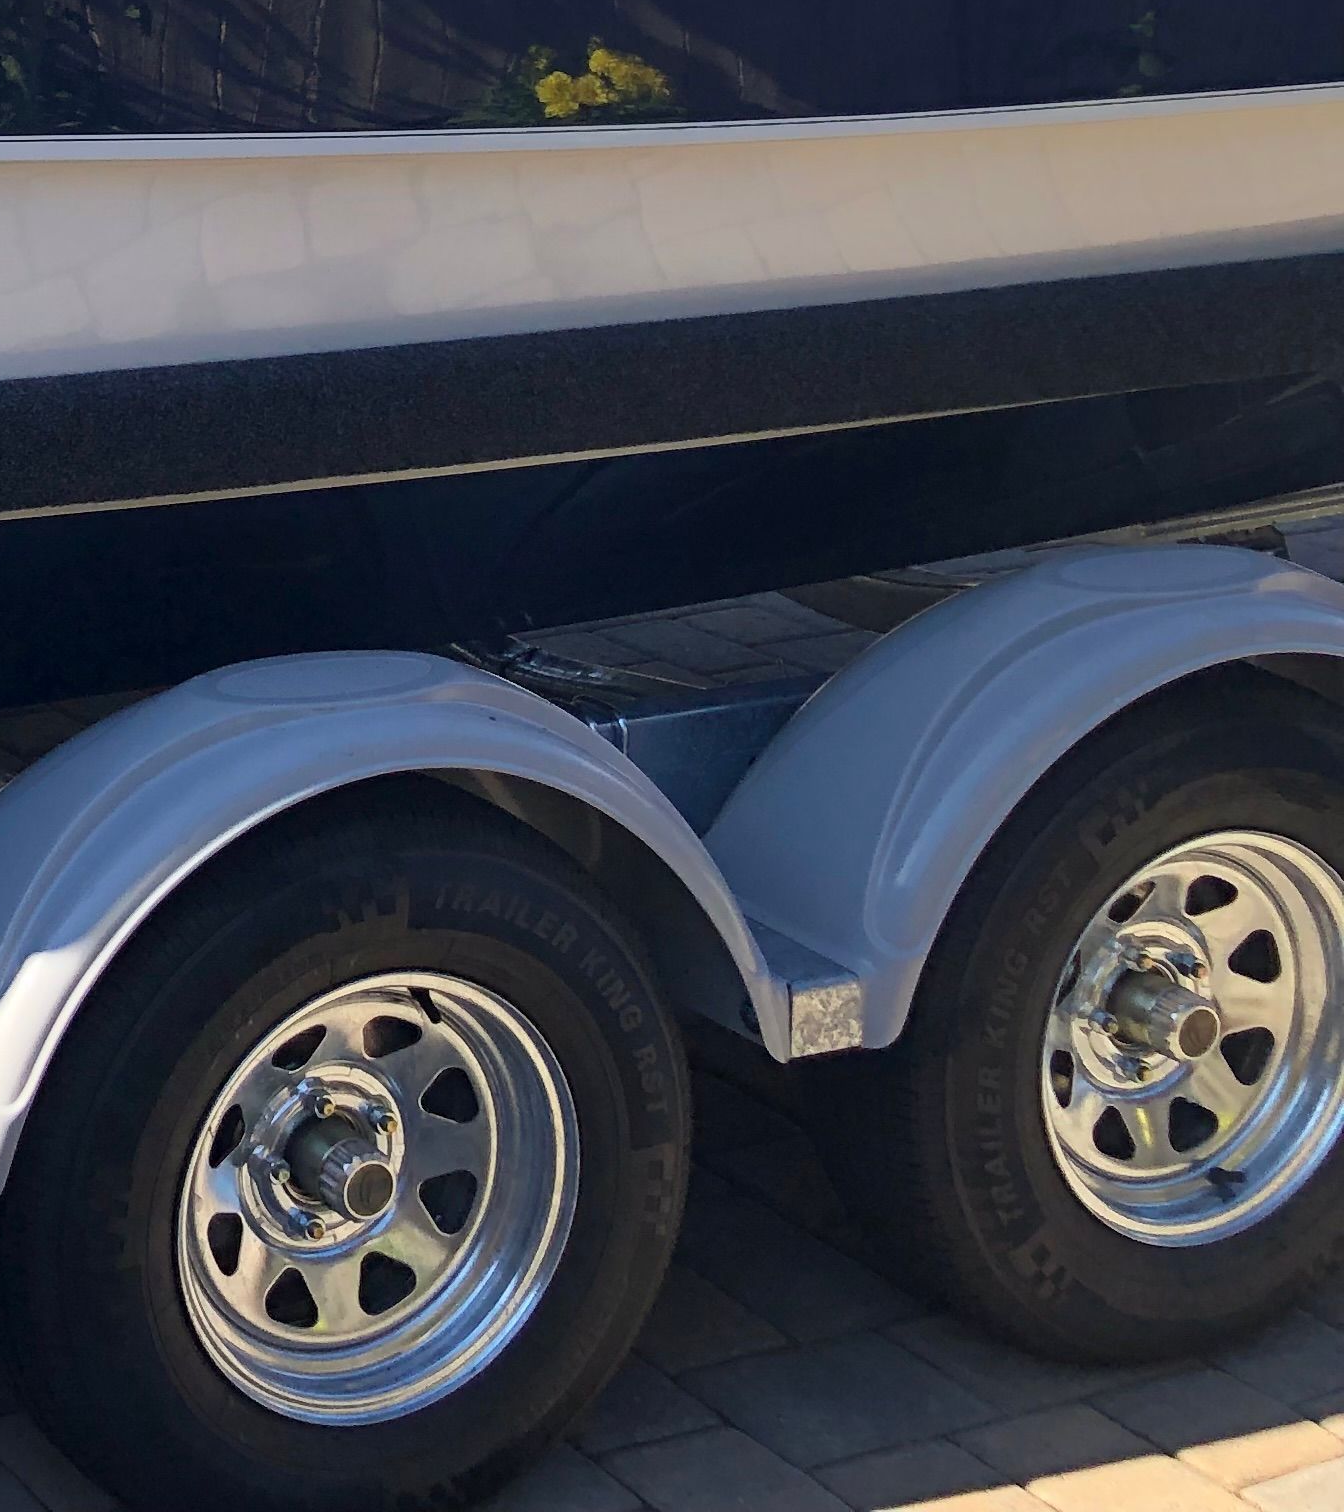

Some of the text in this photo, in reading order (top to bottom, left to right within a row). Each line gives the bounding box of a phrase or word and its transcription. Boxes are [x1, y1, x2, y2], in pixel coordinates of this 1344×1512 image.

[435, 886, 669, 1115] TRAILER KING RST
[975, 1063, 1024, 1228] TRAILER
